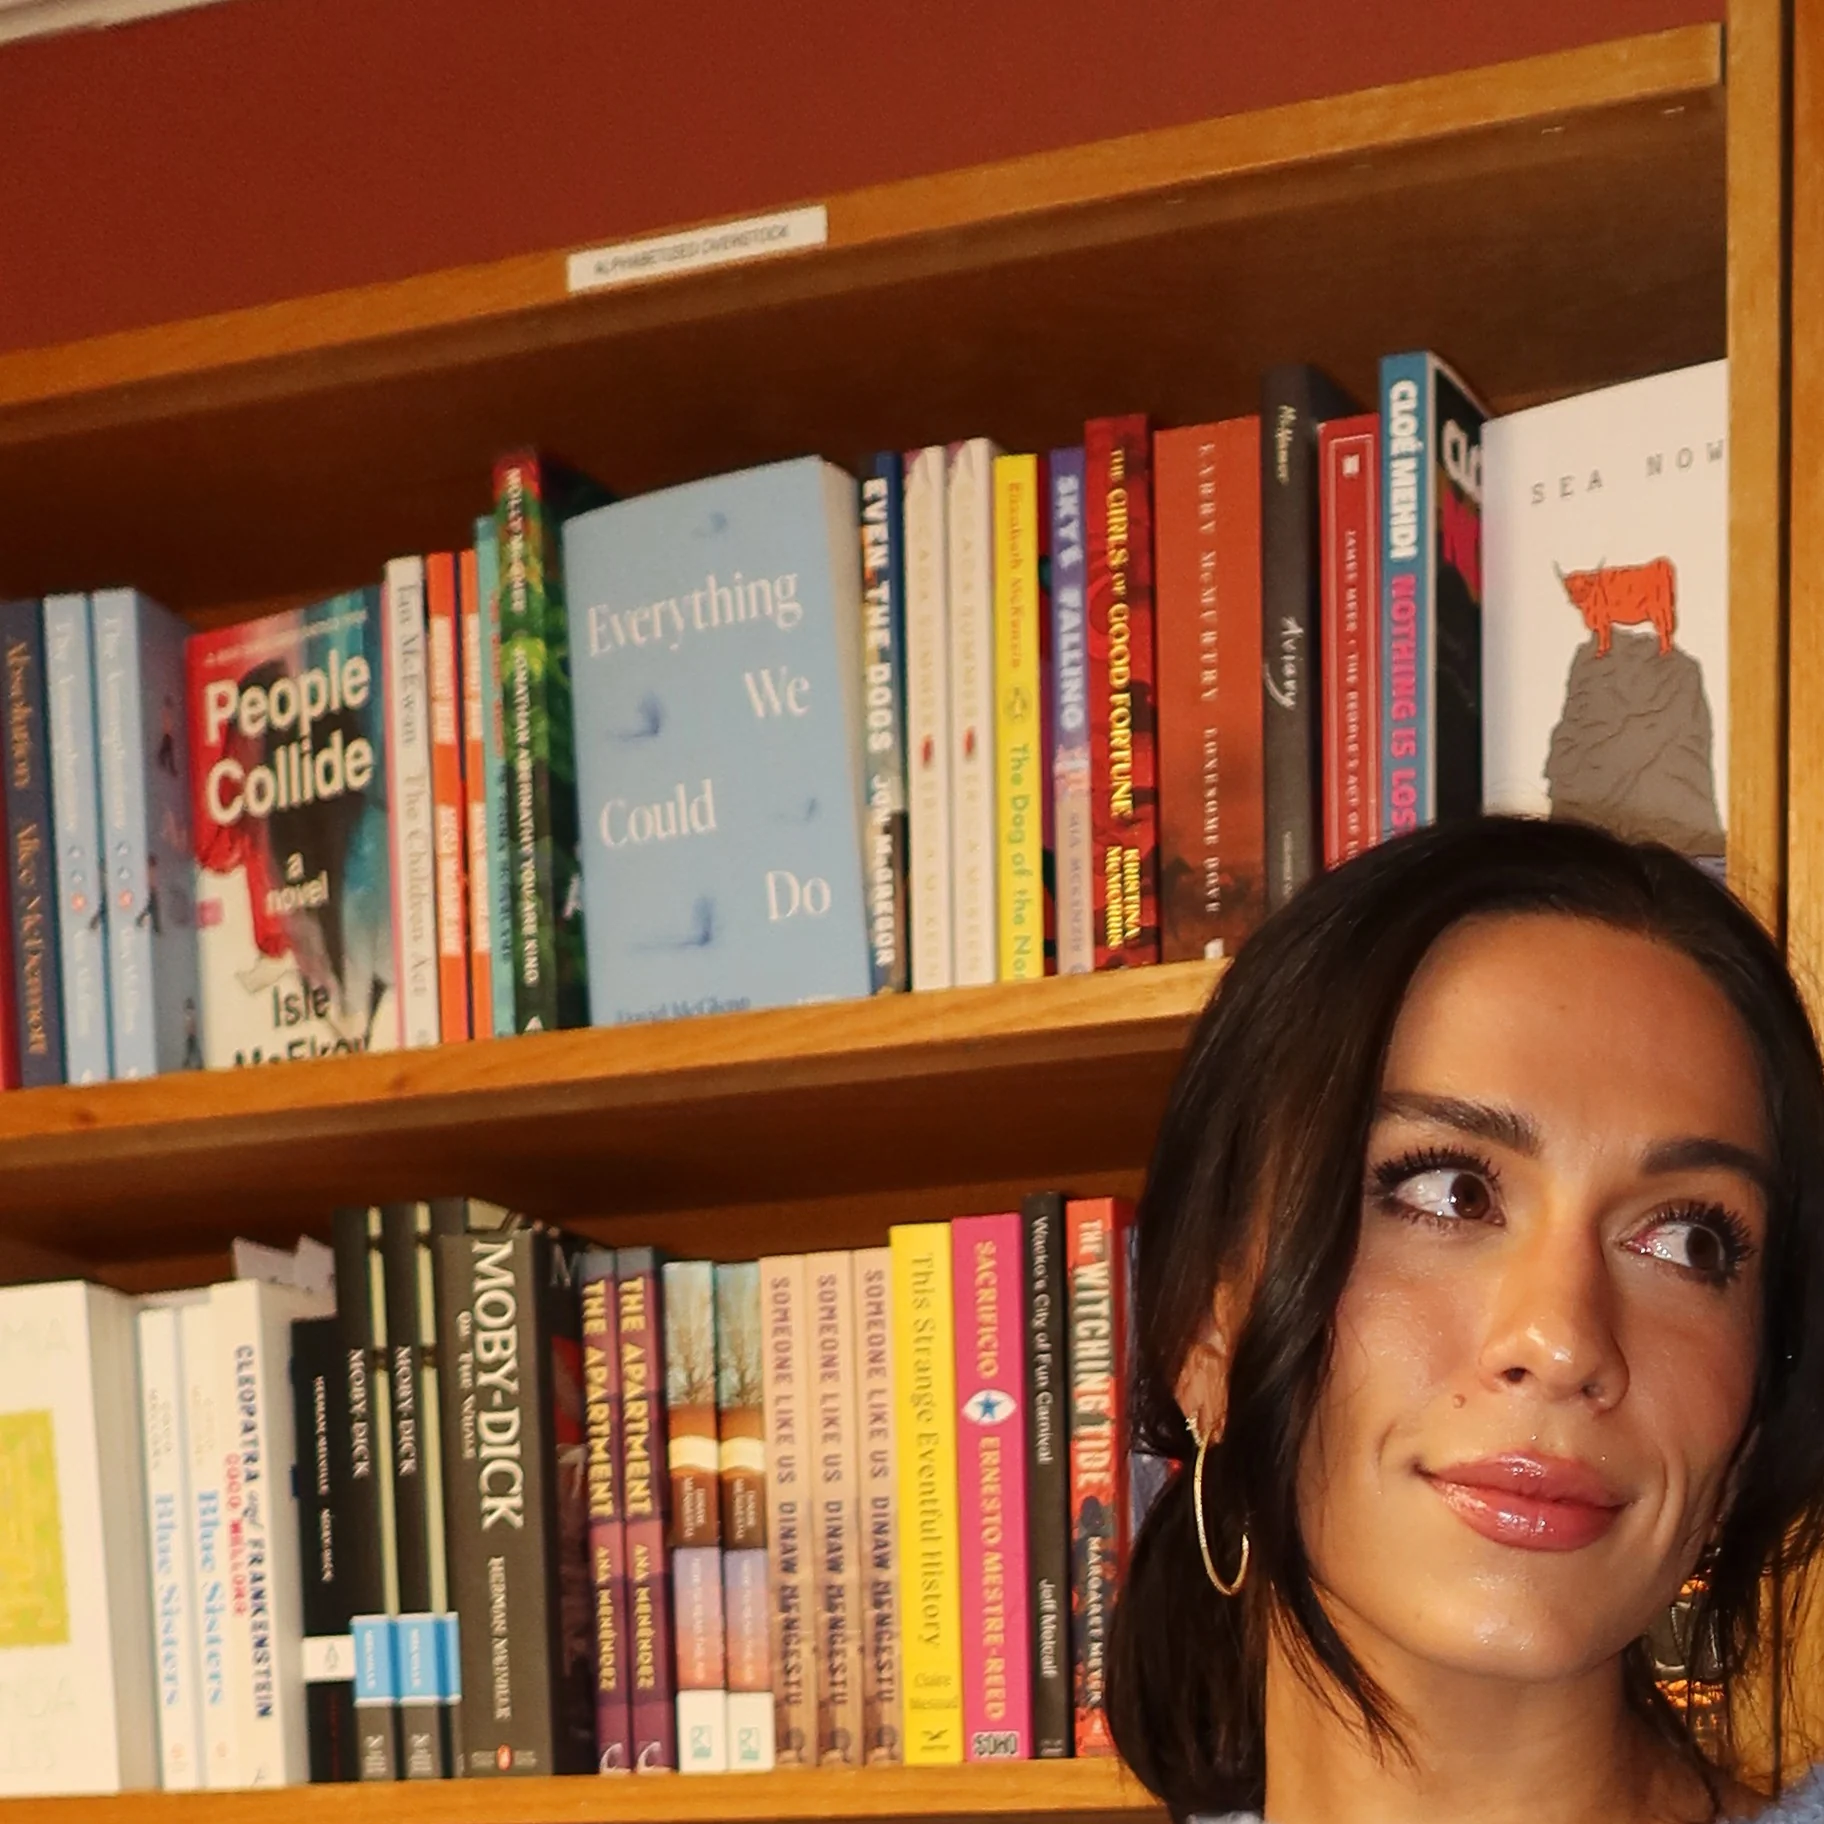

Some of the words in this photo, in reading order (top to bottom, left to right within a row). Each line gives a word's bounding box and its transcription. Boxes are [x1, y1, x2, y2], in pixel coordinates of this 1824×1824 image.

[1529, 468, 1605, 507] SEA
[1648, 439, 1727, 480] NOW
[589, 567, 804, 662] Everything
[204, 651, 372, 746] People
[744, 669, 812, 722] We
[206, 732, 374, 826] Collide
[602, 780, 717, 849] Could
[266, 870, 330, 918] novel
[764, 870, 832, 922] Do
[272, 981, 331, 1030] Isle
[581, 1277, 608, 1340] THE
[911, 1253, 935, 1310] This
[974, 1241, 998, 1379] SACRIFICIO
[864, 1268, 886, 1379] SOMEONE
[471, 1239, 526, 1531] MOBY-DICK
[911, 1317, 937, 1431] Strange
[584, 1347, 615, 1519] APARTMENT
[866, 1384, 887, 1442] LIKE
[870, 1451, 889, 1478] US
[916, 1432, 945, 1548] Eventful
[918, 1553, 945, 1649] History
[972, 1730, 1018, 1757] SOHO
